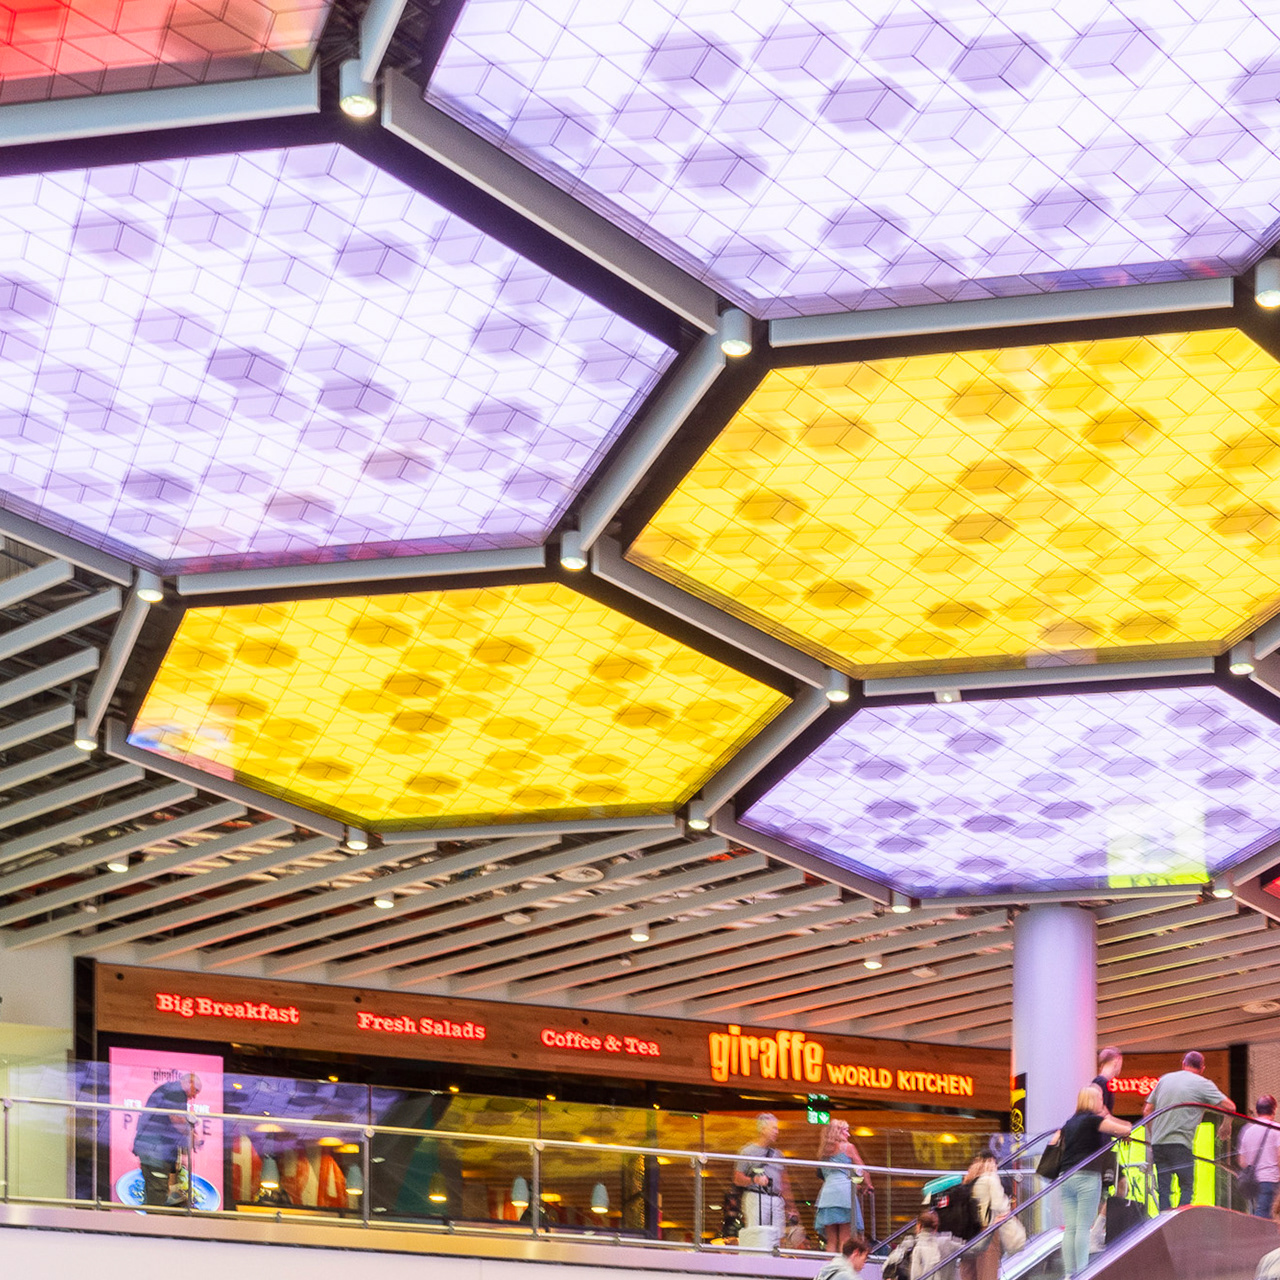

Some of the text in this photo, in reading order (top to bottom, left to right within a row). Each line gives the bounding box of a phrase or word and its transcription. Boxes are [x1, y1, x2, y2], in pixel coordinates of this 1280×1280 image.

[156, 993, 300, 1024] Big Breakfast
[357, 1011, 487, 1041] Fresh Salads
[540, 1028, 661, 1057] Coffee & Tea
[708, 1024, 974, 1097] giraffe WORLD KITCHEN
